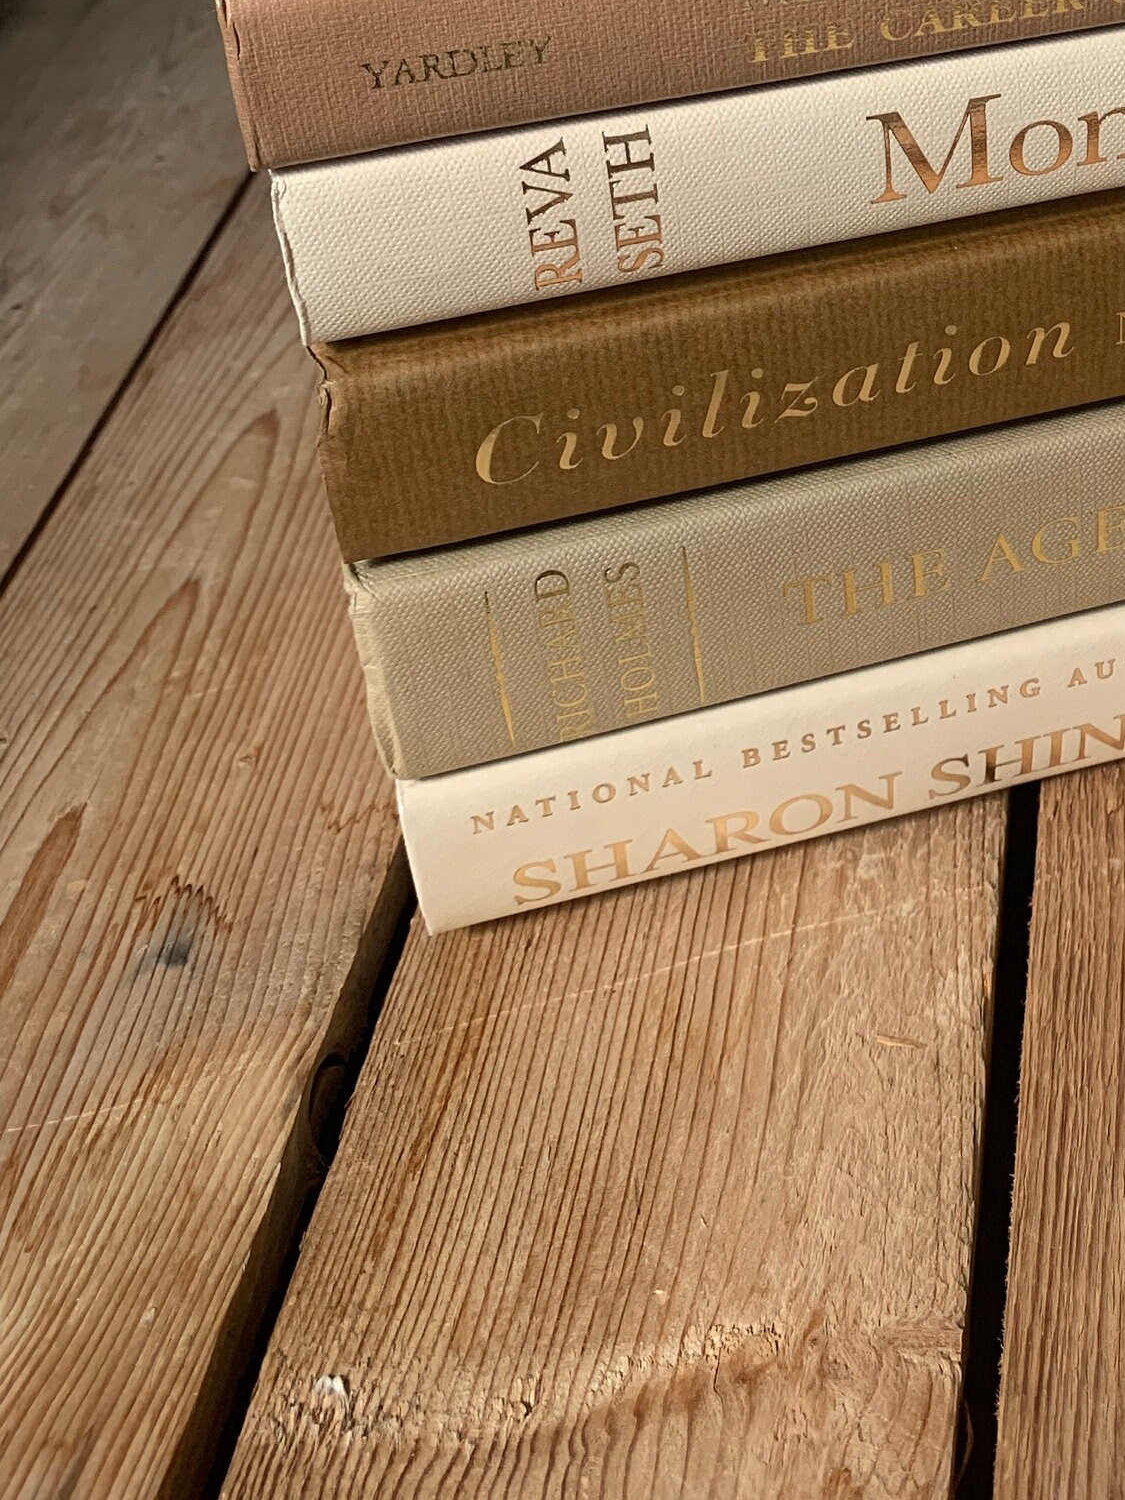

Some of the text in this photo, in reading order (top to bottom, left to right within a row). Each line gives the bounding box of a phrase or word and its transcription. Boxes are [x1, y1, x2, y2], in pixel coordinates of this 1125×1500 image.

[362, 36, 552, 91] YARDLEY
[750, 22, 854, 63] THE
[518, 136, 584, 291] REVA
[601, 124, 666, 274] SETH
[477, 312, 1075, 488] Civilization
[534, 569, 599, 742] RICHARD
[604, 562, 658, 718] HOLMES
[784, 548, 951, 625] THE
[471, 757, 712, 834] NATIONAL
[742, 677, 1042, 769] BESTSELLING
[511, 772, 905, 907] SHARON
